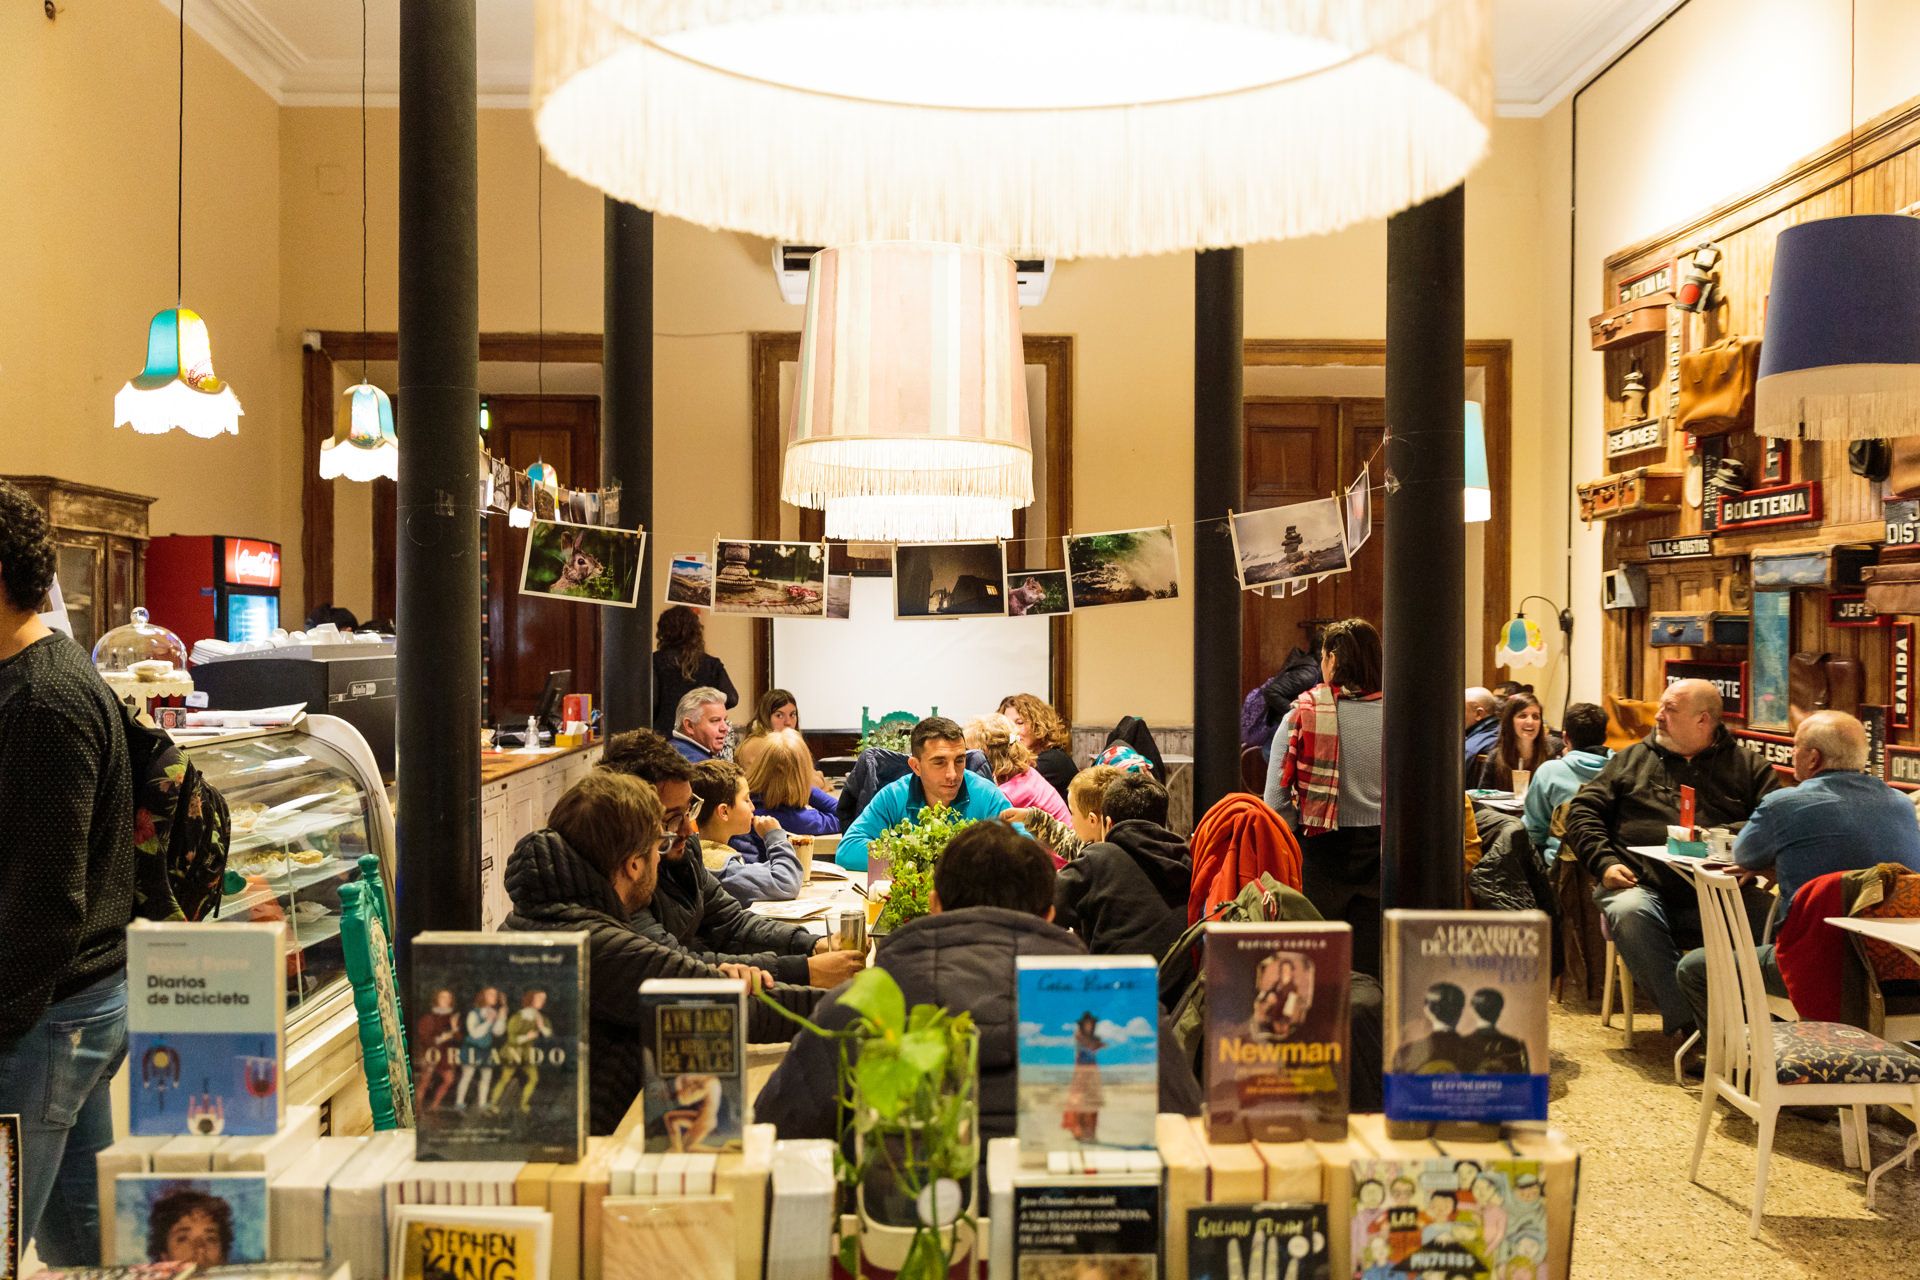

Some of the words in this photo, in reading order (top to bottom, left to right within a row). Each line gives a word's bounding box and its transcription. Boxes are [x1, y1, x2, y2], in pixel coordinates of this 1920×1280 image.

[1609, 424, 1658, 453] SEÑORES
[1724, 493, 1806, 521] BOLETERIA
[1895, 637, 1908, 715] SALIDA
[1765, 743, 1794, 764] ESP
[147, 975, 206, 989] Diarios
[147, 992, 170, 1005] de
[174, 992, 250, 1005] bicicleta
[424, 1047, 566, 1065] ORLANDO
[1218, 1036, 1343, 1064] Newman
[1390, 1210, 1417, 1228] LAS
[421, 1227, 517, 1257] STEPHEN
[422, 1253, 517, 1280] KING
